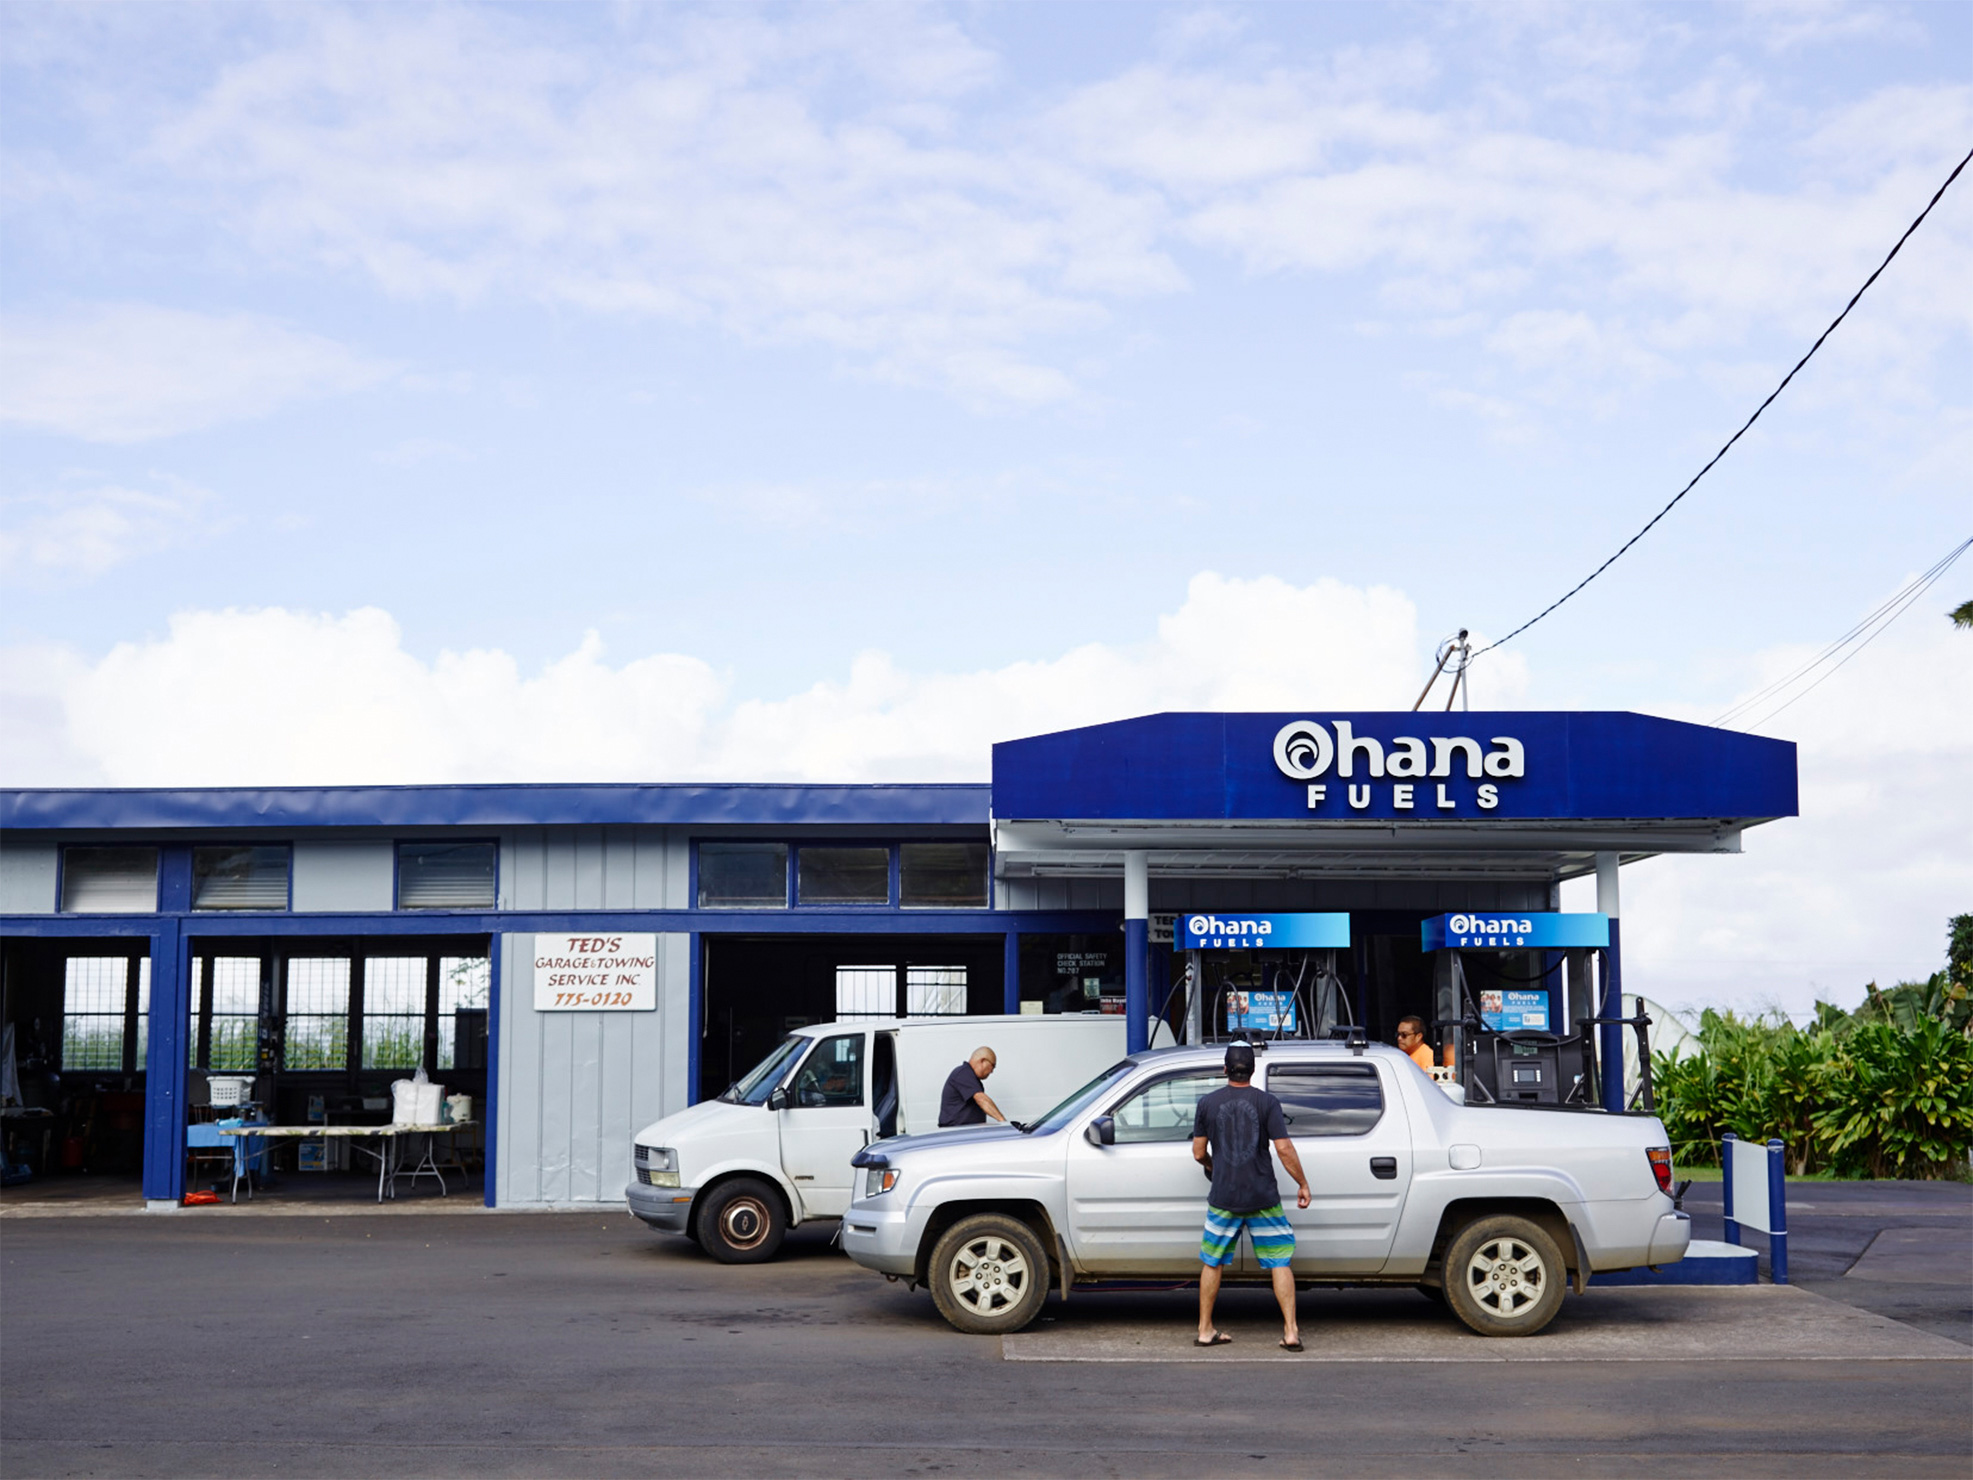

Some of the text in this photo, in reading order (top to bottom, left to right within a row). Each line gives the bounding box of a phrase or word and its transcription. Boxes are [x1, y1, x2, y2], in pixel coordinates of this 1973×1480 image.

[1273, 720, 1525, 780] Ohana
[1307, 783, 1499, 809] FUELS
[1189, 915, 1272, 935] Ohana
[1450, 914, 1532, 934] Ohana
[566, 937, 622, 953] TED'S
[1200, 938, 1264, 948] FUELS
[1460, 937, 1524, 946] FUELS
[1056, 952, 1108, 960] OFFICIAL SAFETY
[548, 974, 609, 986] SERVICE
[554, 992, 632, 1007] 775-0120
